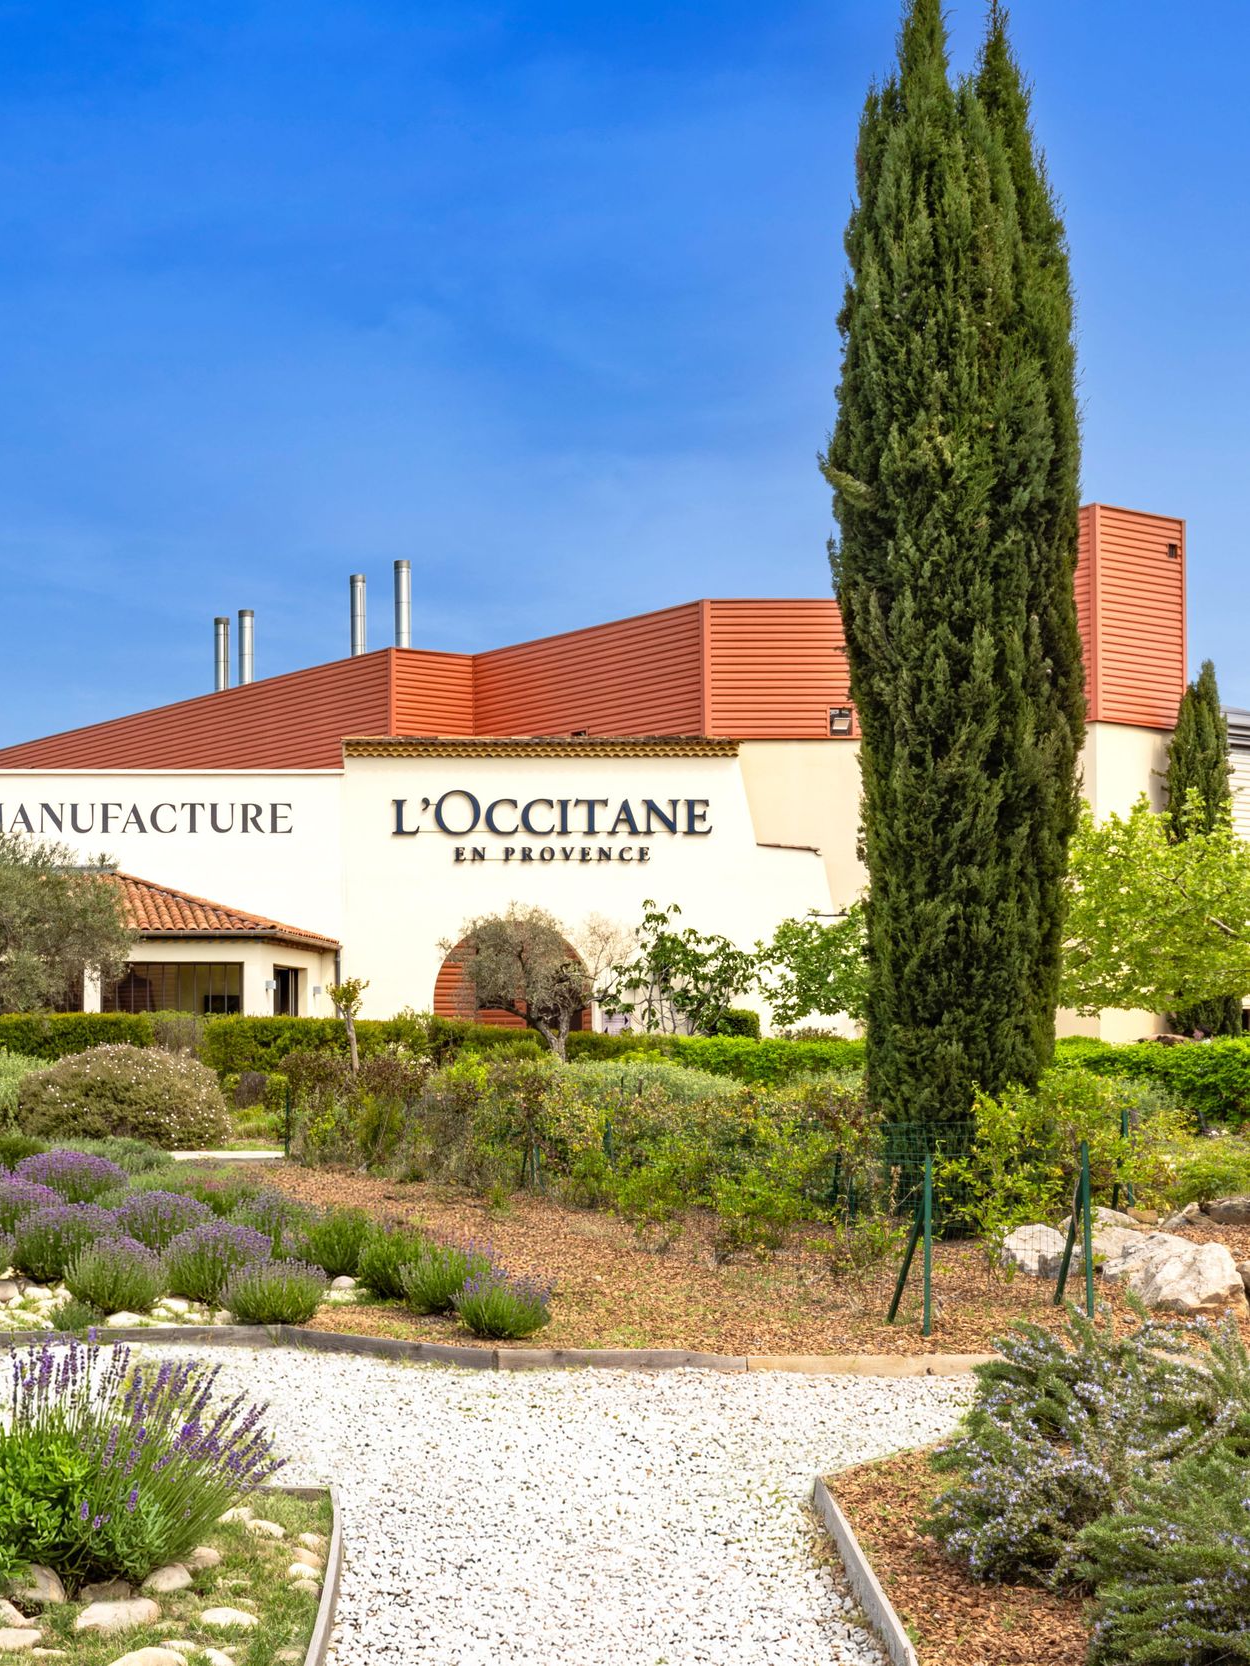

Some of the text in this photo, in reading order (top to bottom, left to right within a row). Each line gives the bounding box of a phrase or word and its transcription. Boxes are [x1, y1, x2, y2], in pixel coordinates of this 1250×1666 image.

[391, 789, 713, 836] L'OCCITANE
[453, 846, 651, 863] EN PROVENCE
